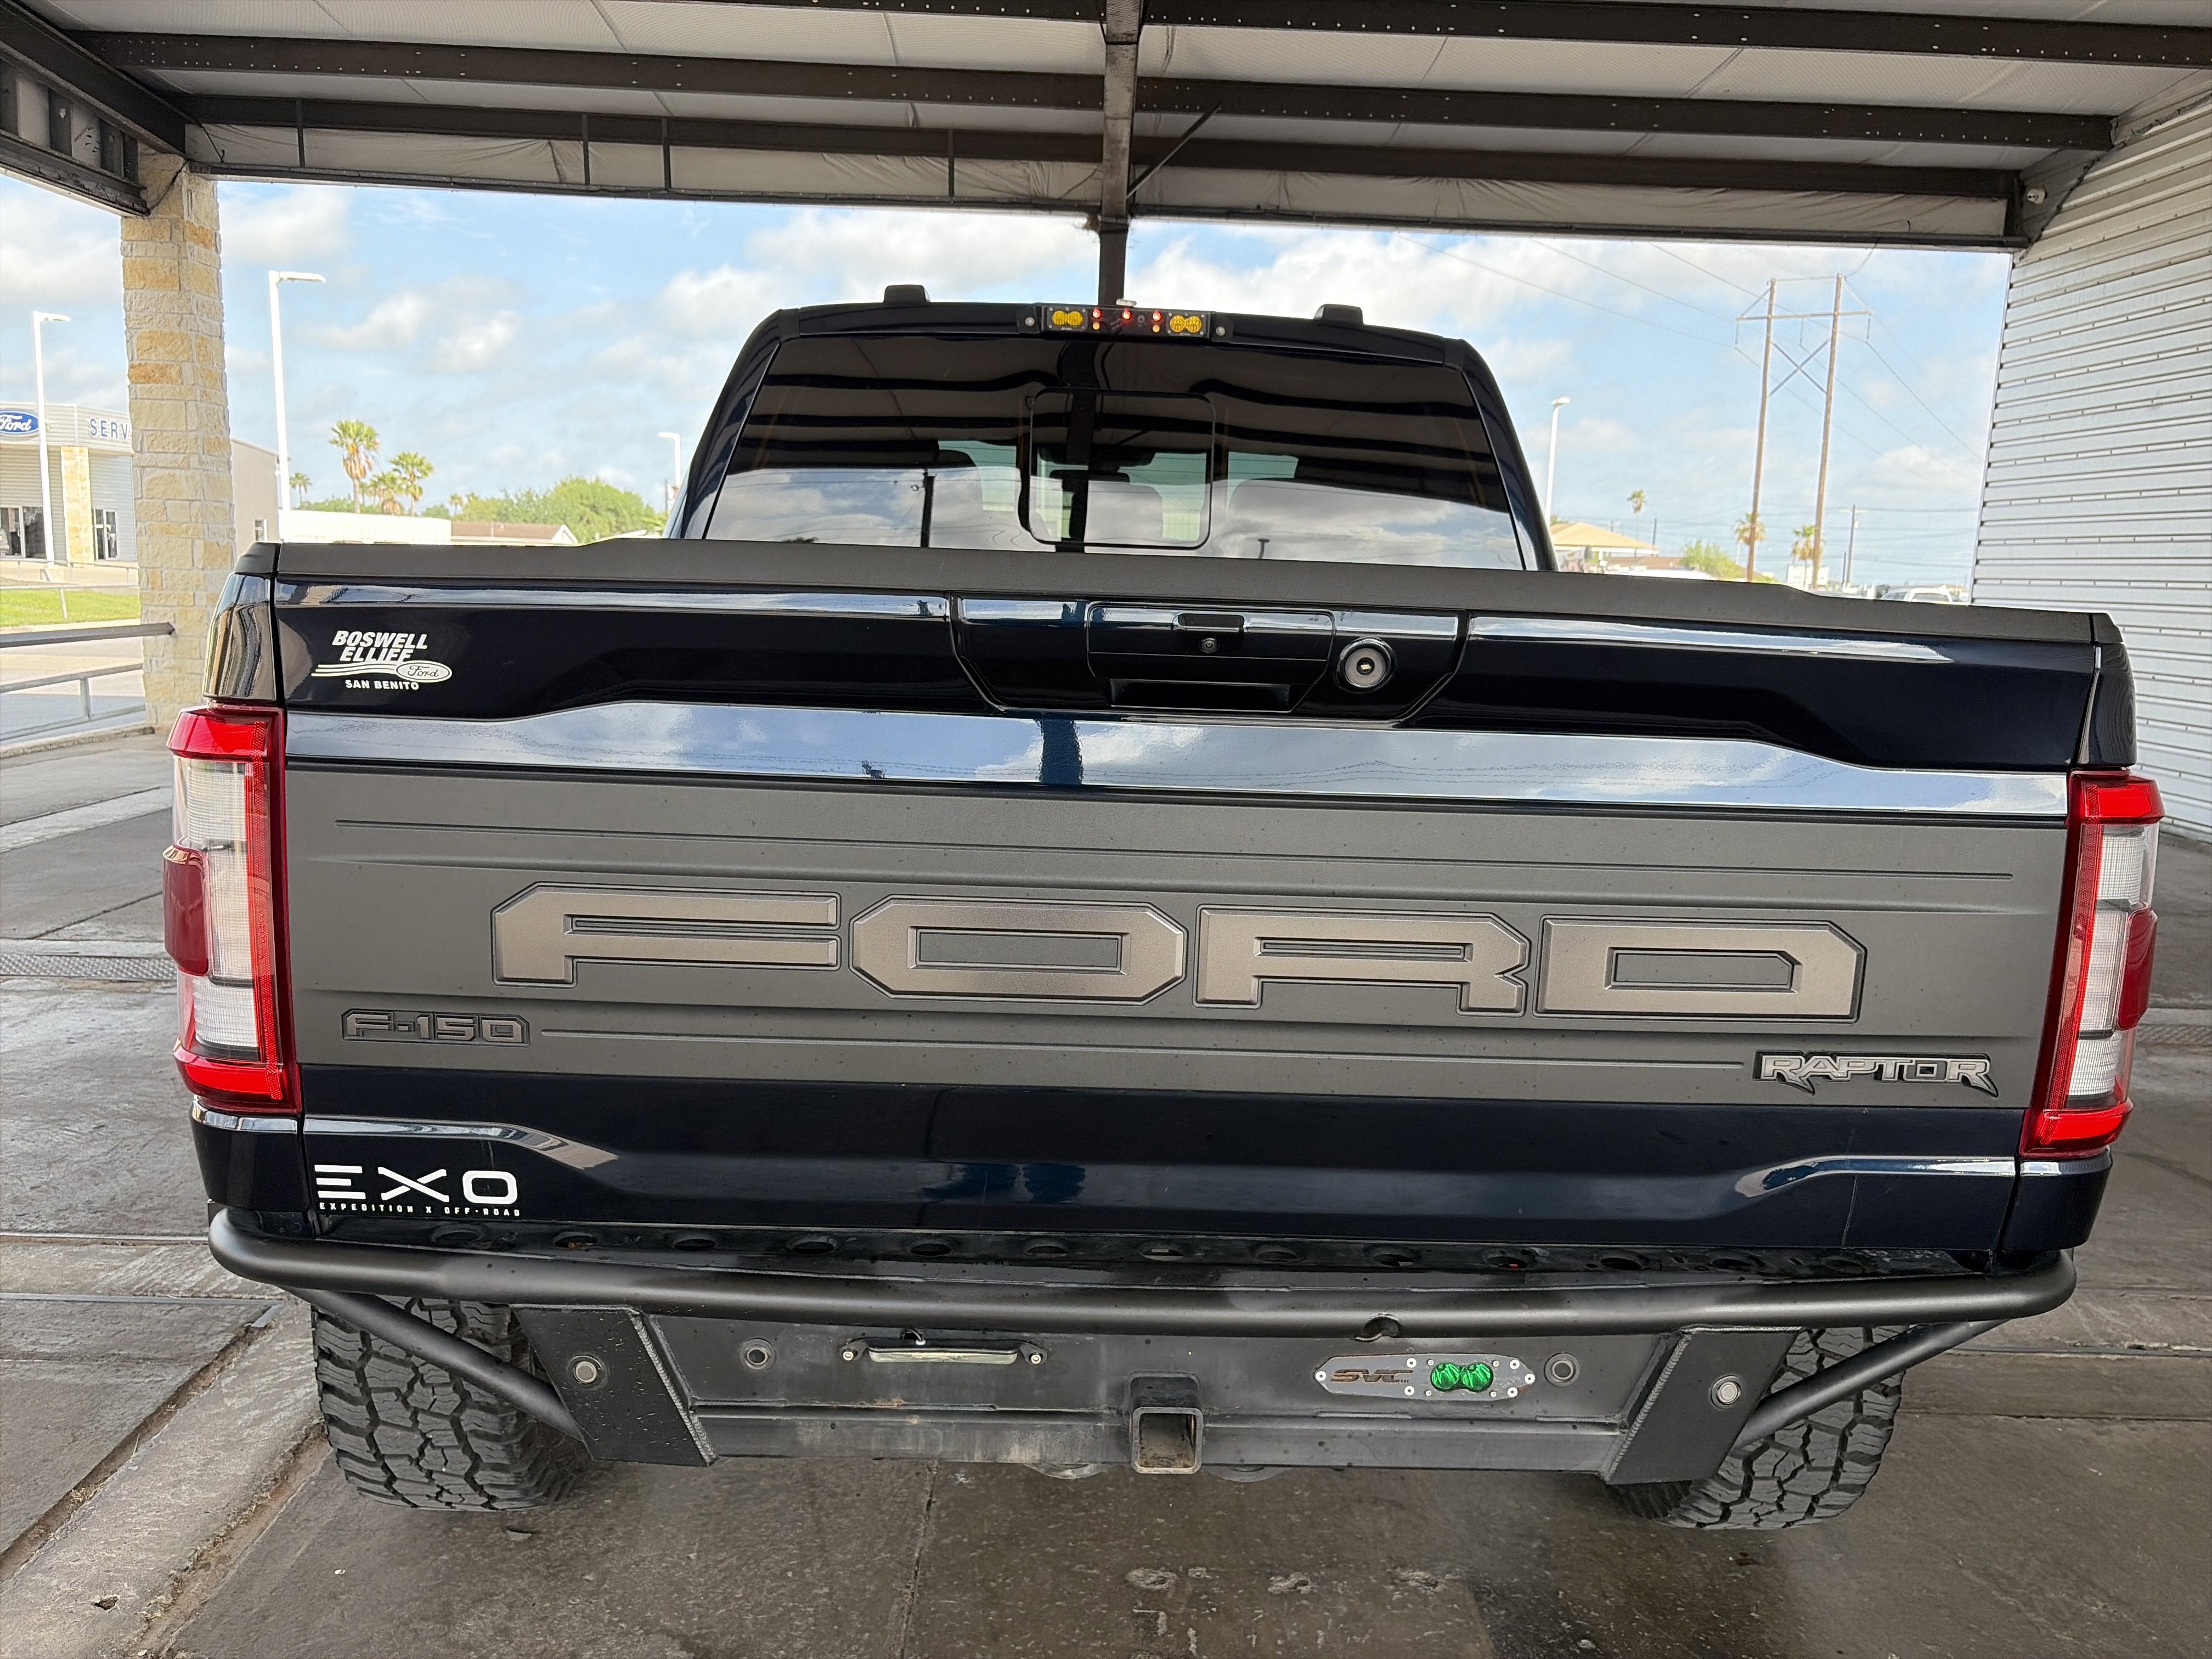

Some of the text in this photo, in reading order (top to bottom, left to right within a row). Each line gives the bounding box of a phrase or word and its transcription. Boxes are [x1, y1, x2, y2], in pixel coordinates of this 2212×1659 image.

[0, 414, 32, 431] Ford
[332, 630, 428, 650] BOSWELL
[407, 665, 439, 678] Ford
[345, 679, 419, 691] SAN BENITO
[493, 882, 1865, 1023] FORD
[343, 1010, 528, 1046] F-150
[1757, 1052, 1999, 1098] RAPTOR
[314, 1164, 518, 1205] EXO
[319, 1202, 414, 1214] EXPEDITION
